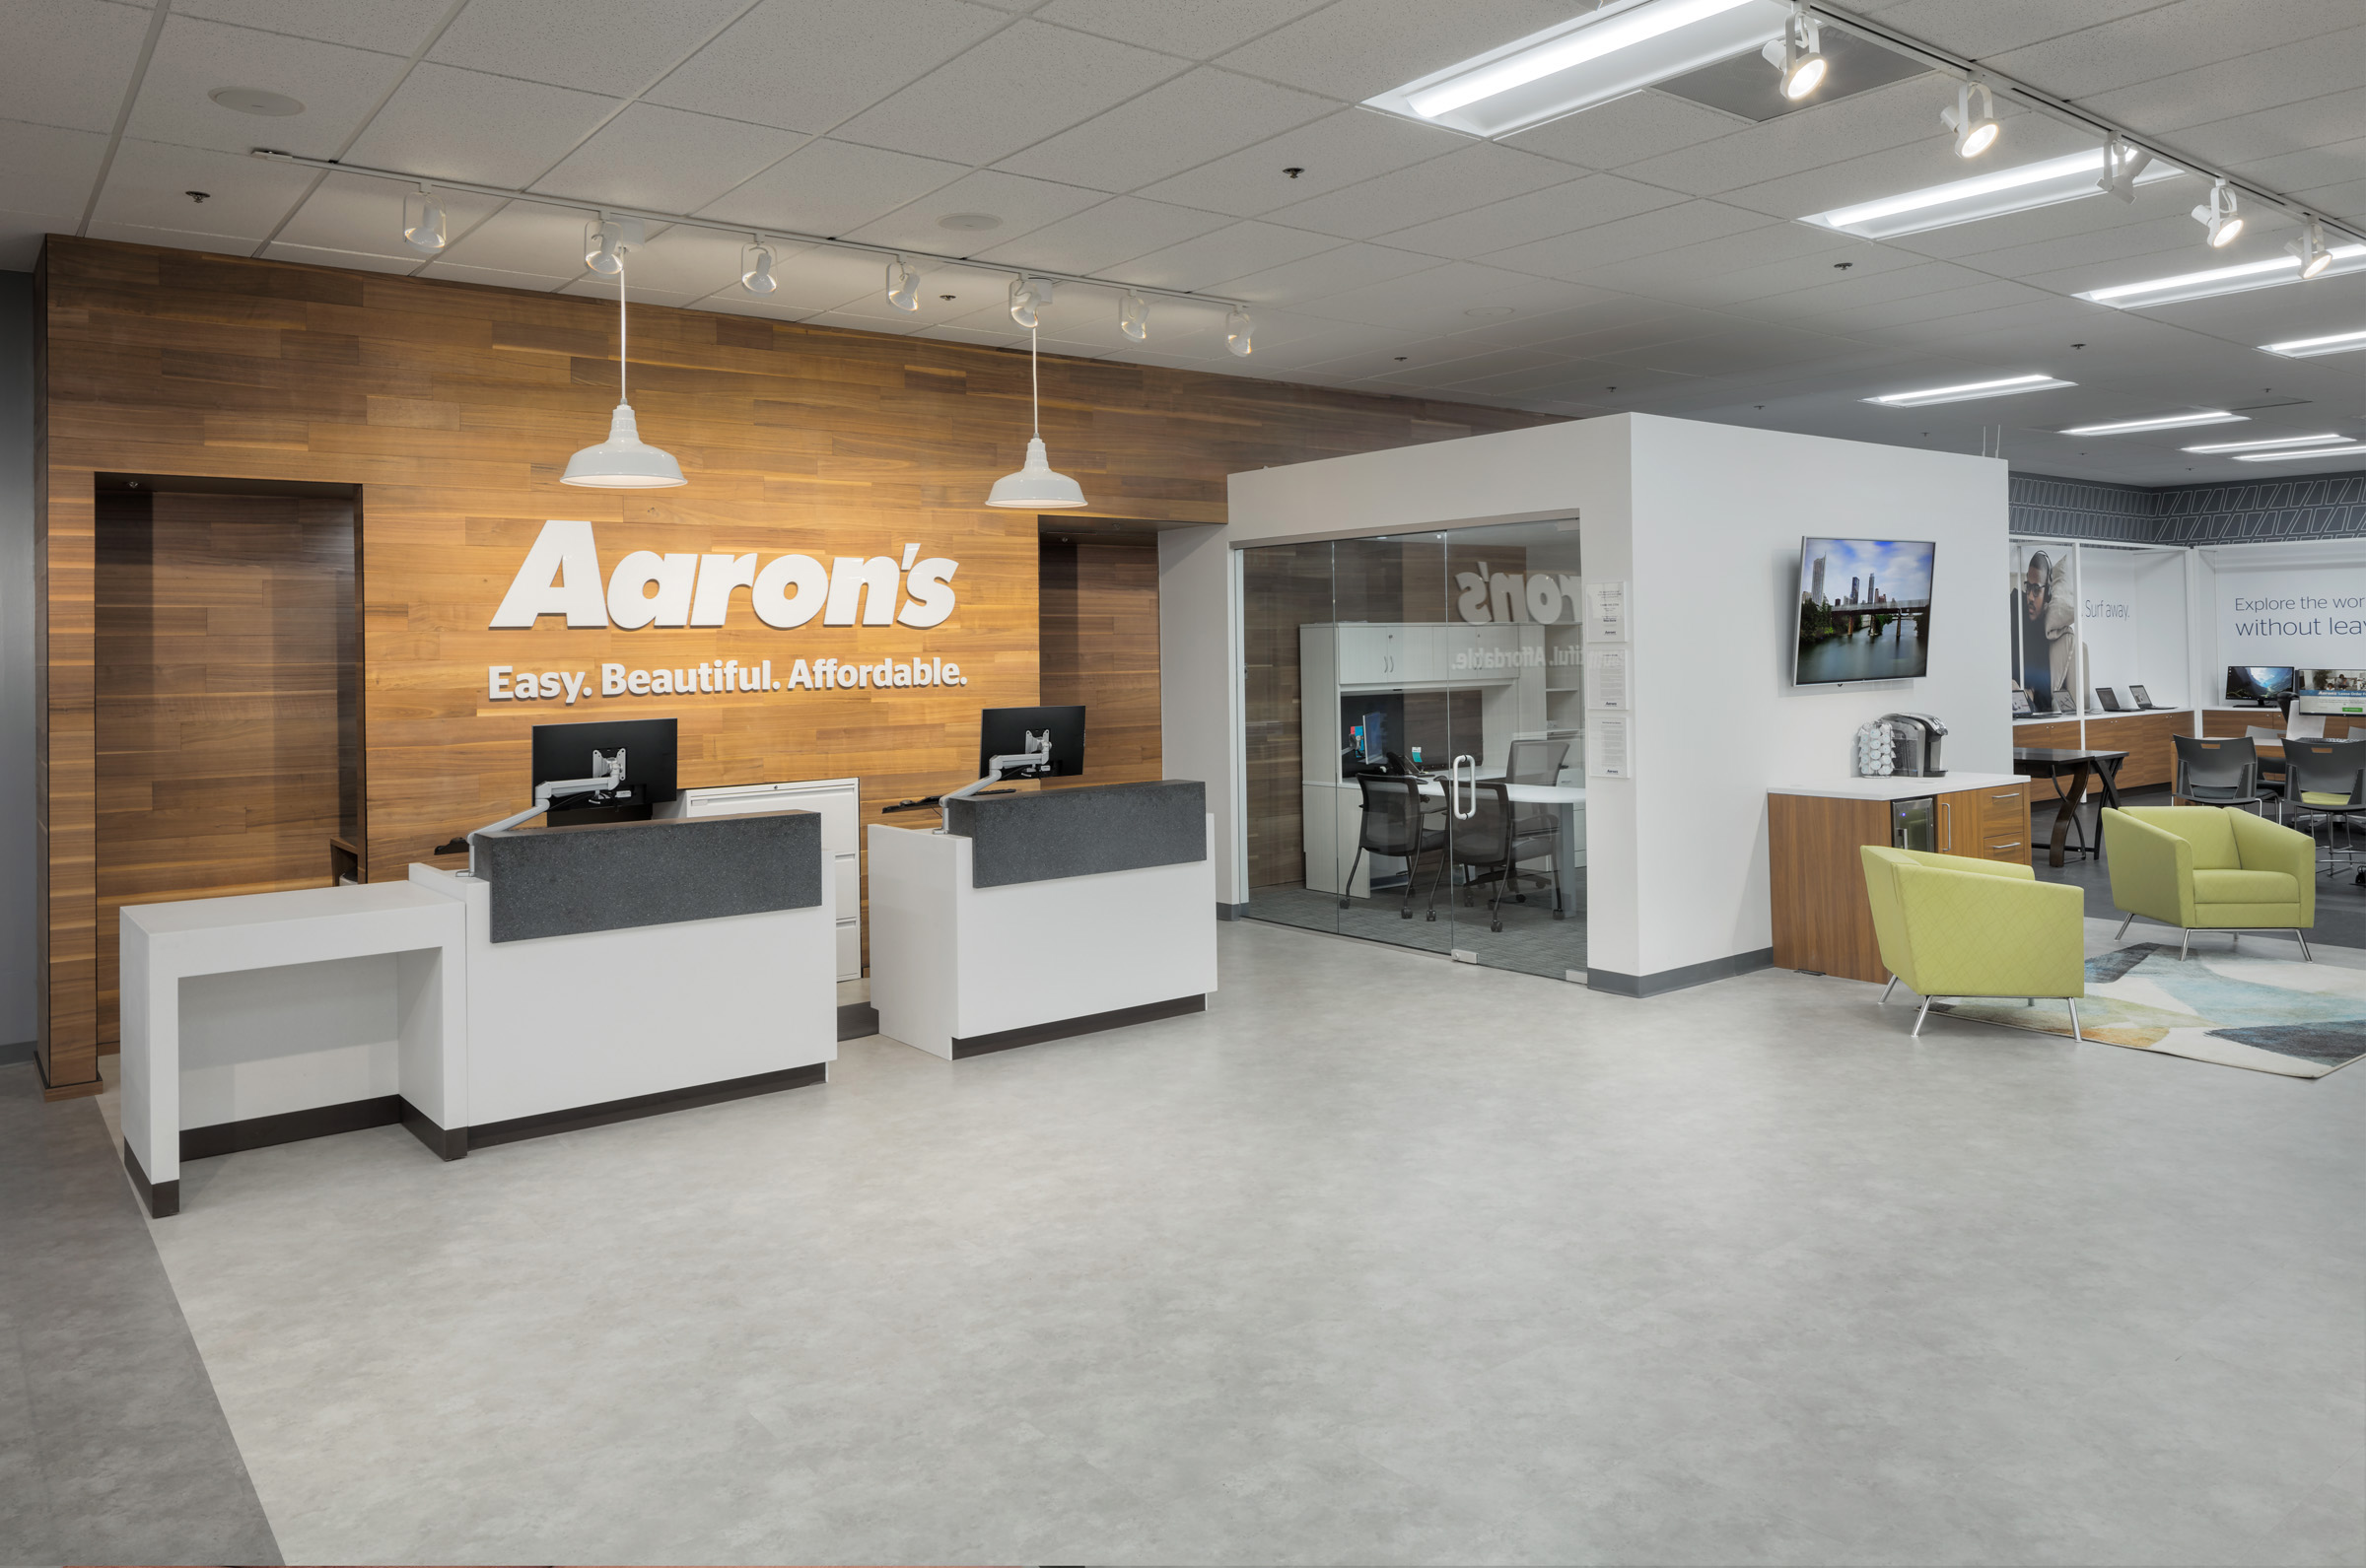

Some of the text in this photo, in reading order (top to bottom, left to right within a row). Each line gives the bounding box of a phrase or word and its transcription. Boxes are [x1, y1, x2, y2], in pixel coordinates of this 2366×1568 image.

[488, 519, 959, 630] Aaron's
[2085, 599, 2130, 621] Surf away.
[2235, 597, 2295, 613] Explore
[2300, 596, 2328, 609] the
[2235, 618, 2322, 636] without
[488, 656, 968, 706] Easy. Beautiful. Affordable.
